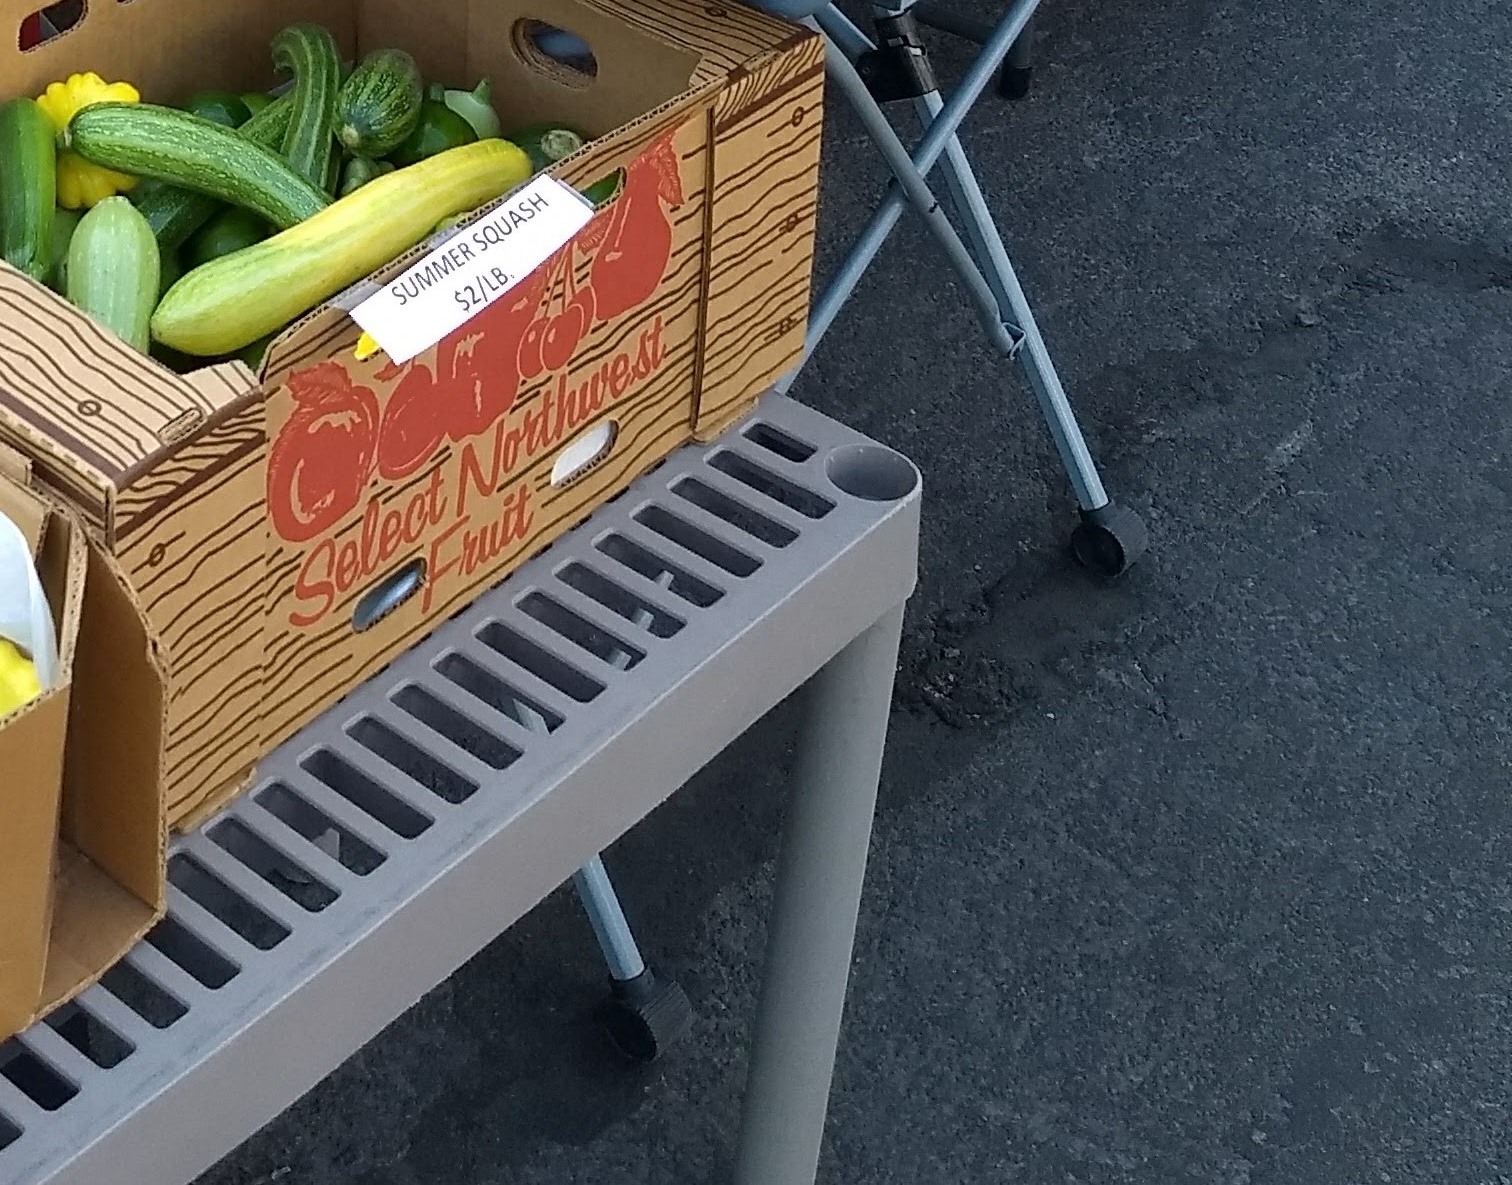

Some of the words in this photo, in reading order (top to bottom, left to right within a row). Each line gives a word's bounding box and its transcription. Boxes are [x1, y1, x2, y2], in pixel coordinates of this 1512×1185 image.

[391, 242, 476, 306] SUMMER
[472, 192, 550, 251] SQUASH
[454, 267, 515, 313] $2/LB.
[289, 467, 448, 627] Select
[457, 315, 667, 517] Northwest
[422, 484, 534, 615] Fruit
